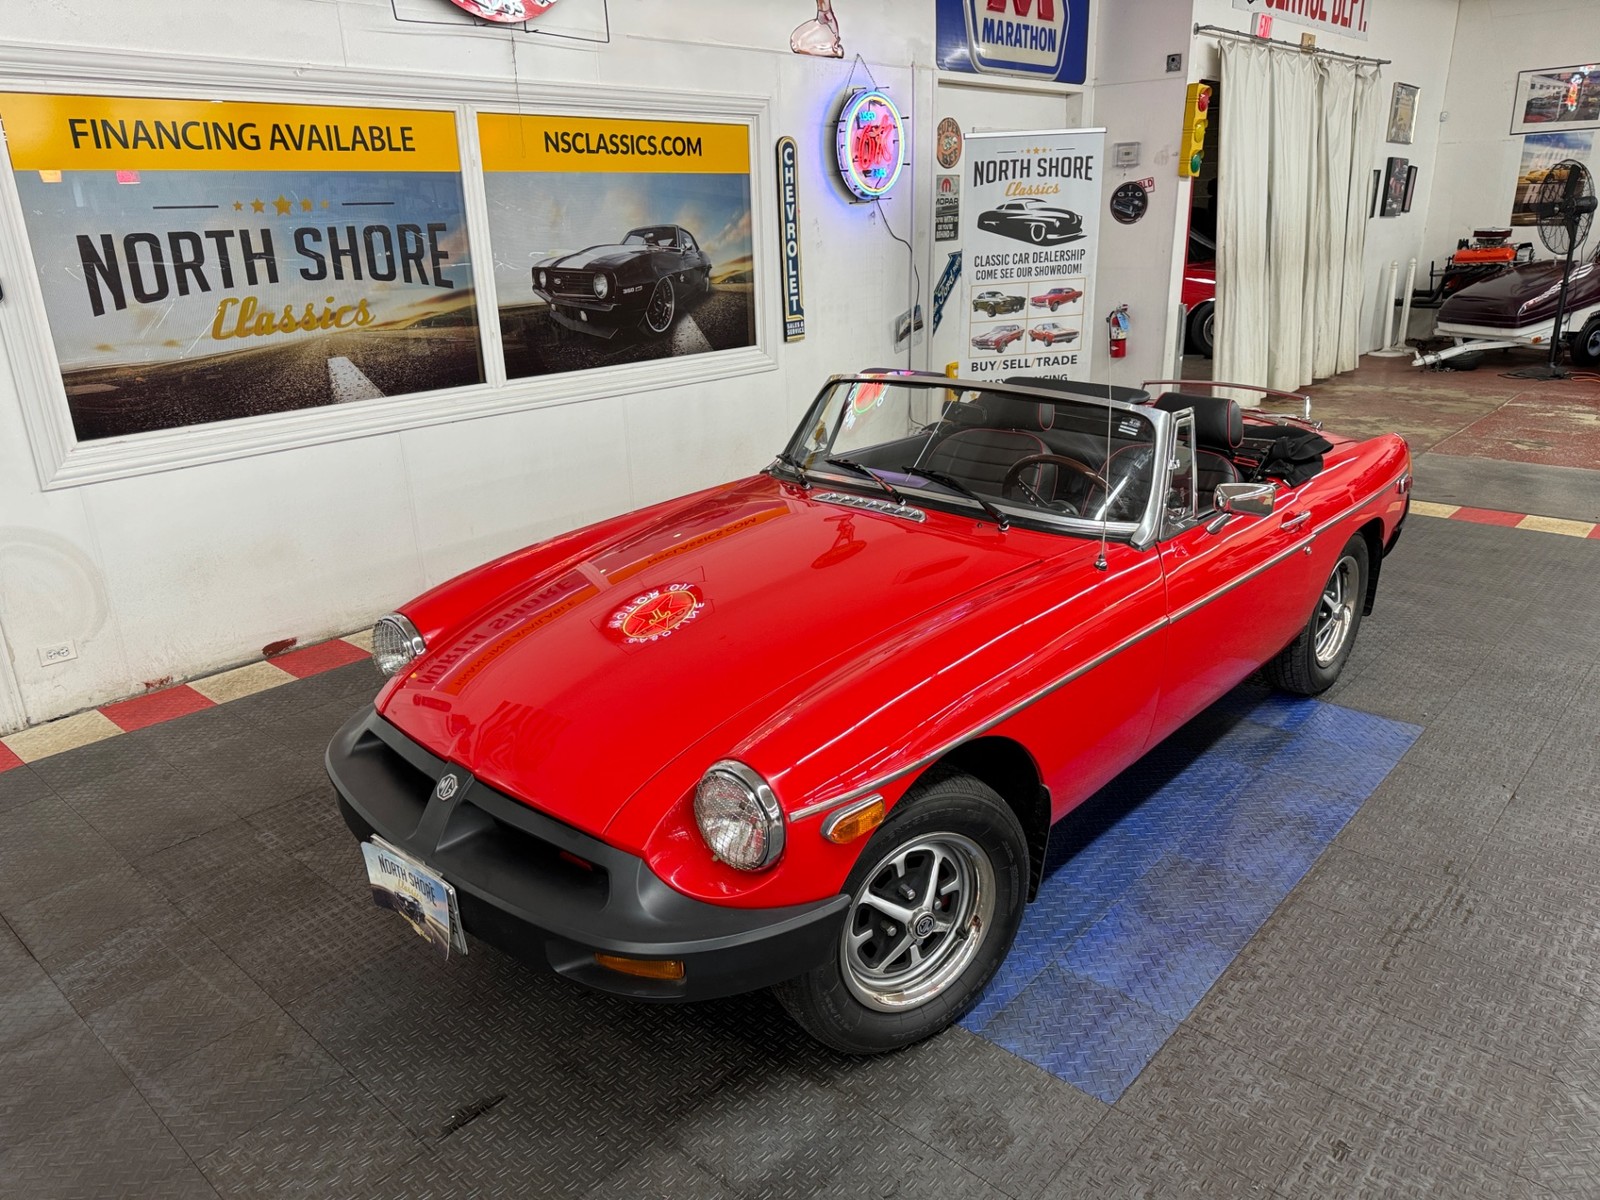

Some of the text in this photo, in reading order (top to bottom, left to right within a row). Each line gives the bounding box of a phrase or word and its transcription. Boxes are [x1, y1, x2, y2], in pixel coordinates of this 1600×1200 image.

[981, 17, 1056, 53] MARATHON
[68, 118, 416, 152] FINANCING AVAILABLE
[543, 131, 703, 157] NSCLASSICS.COM
[973, 155, 1094, 187] NORTH SHORE
[1004, 181, 1061, 197] Classics
[783, 147, 798, 312] CHEVROLET
[76, 222, 454, 317] NORTH SHORE
[974, 253, 1010, 267] CLASSIC
[1012, 252, 1030, 265] CAR
[1032, 249, 1086, 263] DEALERSHIP
[975, 263, 1083, 281] COME SEE OUR SHOWROOM!
[938, 269, 955, 305] Ford
[211, 296, 377, 341] Classics
[377, 853, 437, 908] NORTH SHORE
